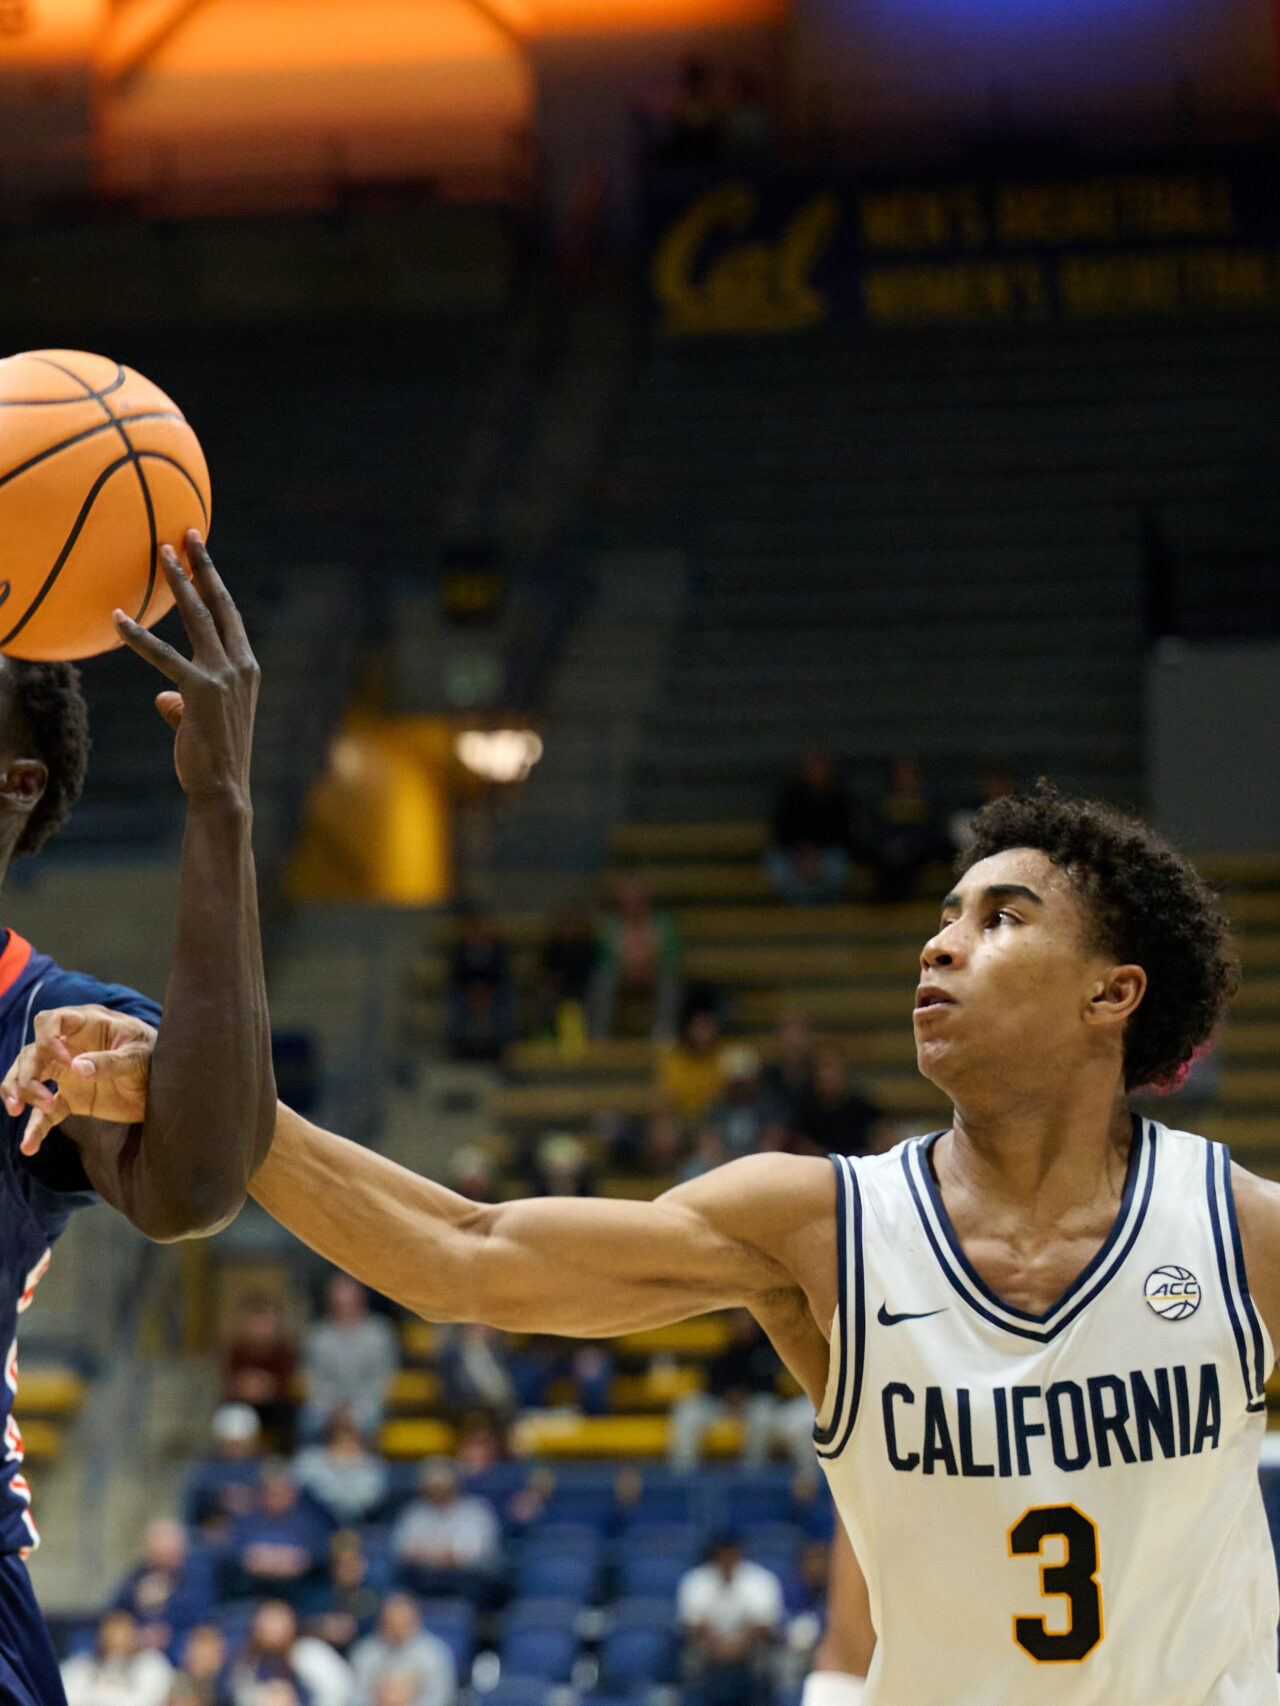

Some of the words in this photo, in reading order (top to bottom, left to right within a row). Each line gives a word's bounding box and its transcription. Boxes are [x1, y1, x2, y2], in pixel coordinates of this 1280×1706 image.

[651, 181, 841, 338] Cal
[1151, 1282, 1197, 1296] ACC
[881, 1363, 1221, 1477] CALIFORNIA
[1007, 1503, 1105, 1665] 3
